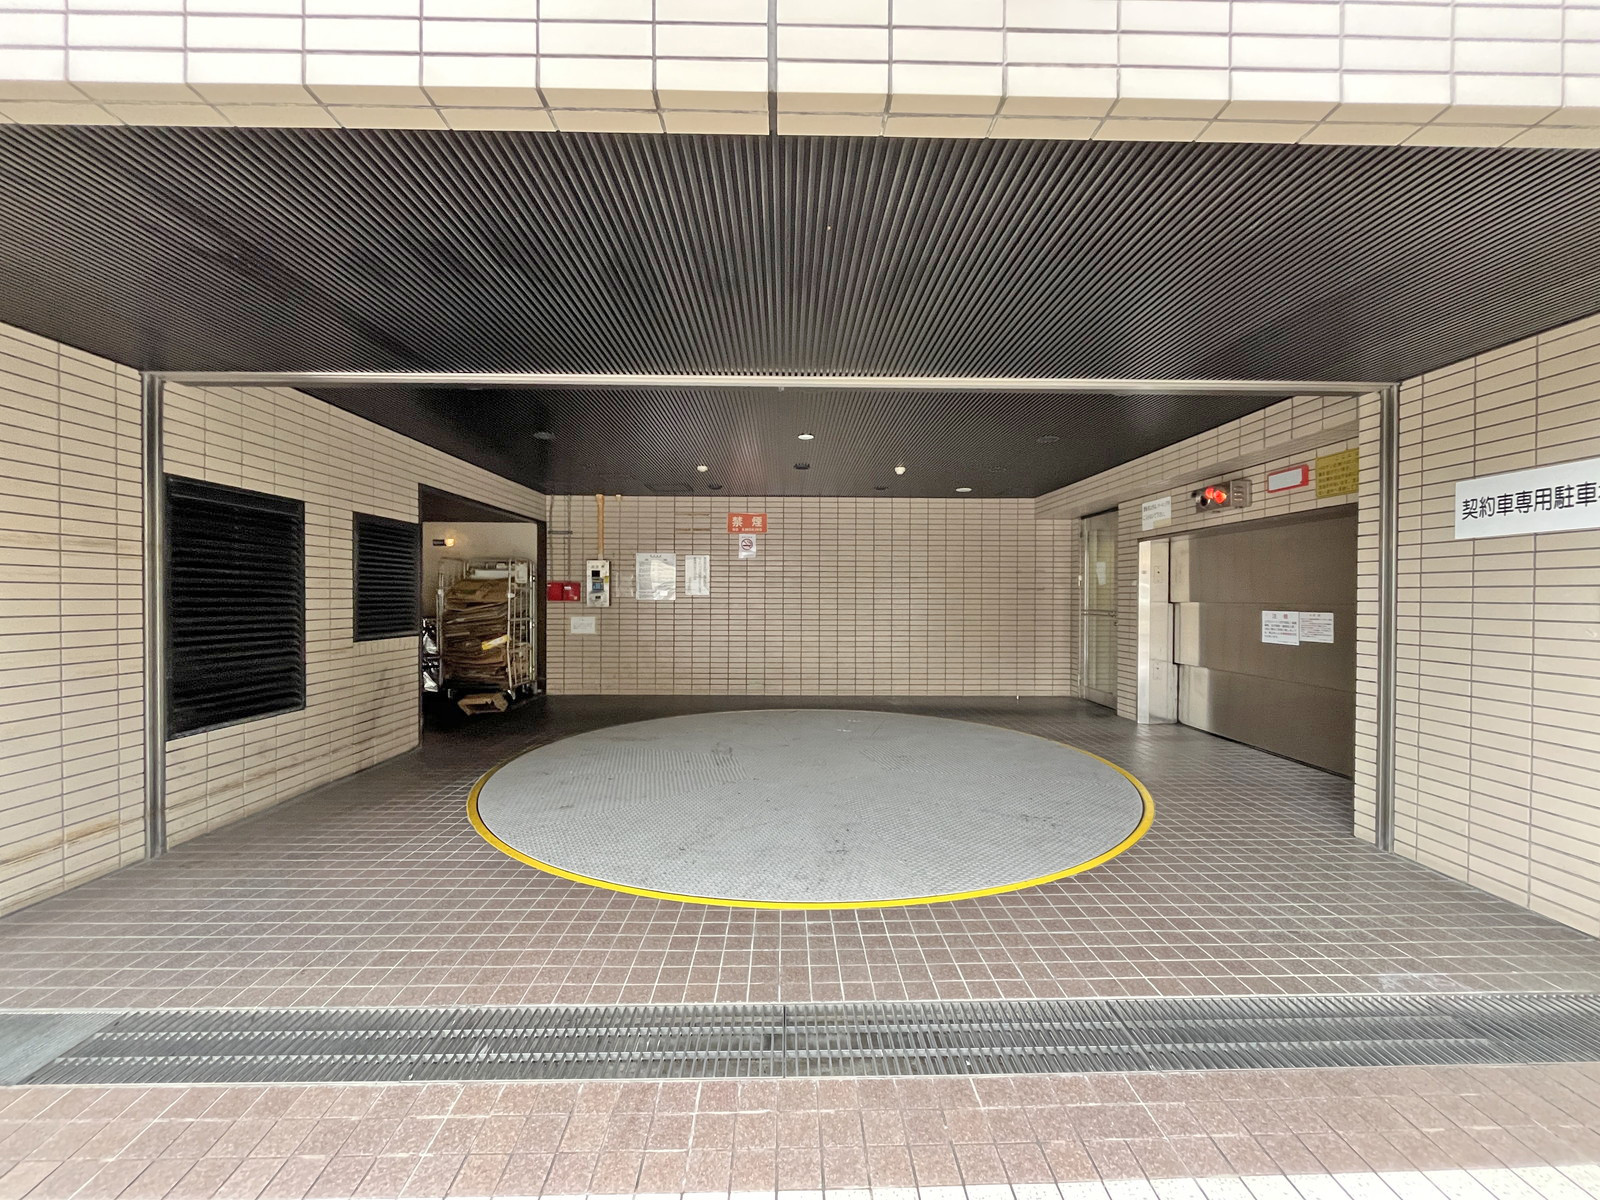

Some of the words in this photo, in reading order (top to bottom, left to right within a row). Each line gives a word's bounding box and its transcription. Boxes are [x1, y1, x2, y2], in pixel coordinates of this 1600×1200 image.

[1461, 481, 1600, 521] 契約車専用駐車
[731, 516, 763, 527] 禁煙
